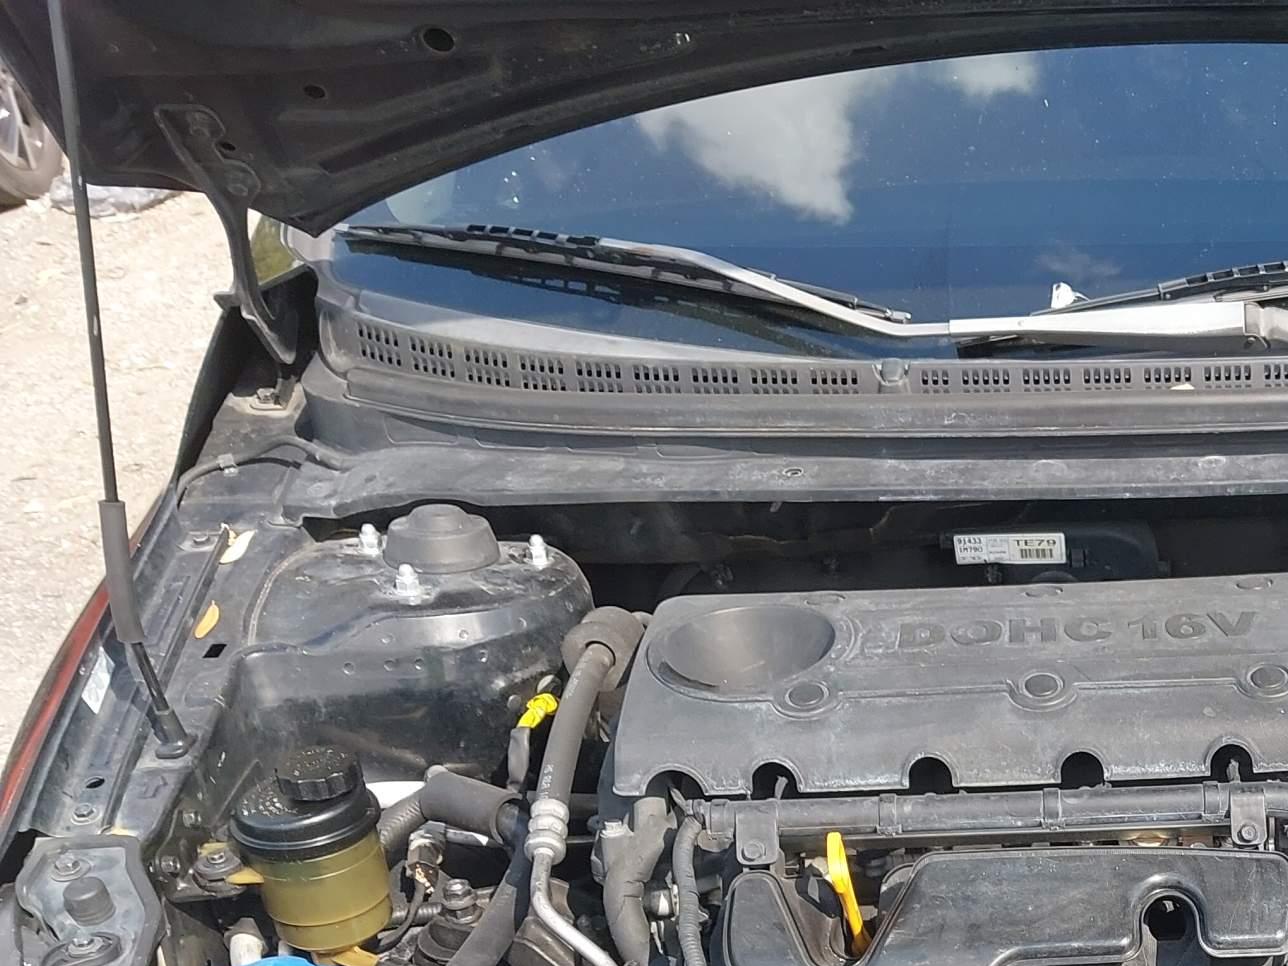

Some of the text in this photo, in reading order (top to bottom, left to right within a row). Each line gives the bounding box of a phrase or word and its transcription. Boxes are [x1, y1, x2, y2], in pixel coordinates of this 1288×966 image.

[1014, 539, 1056, 547] TE79
[898, 610, 1257, 650] DOHC 16V
